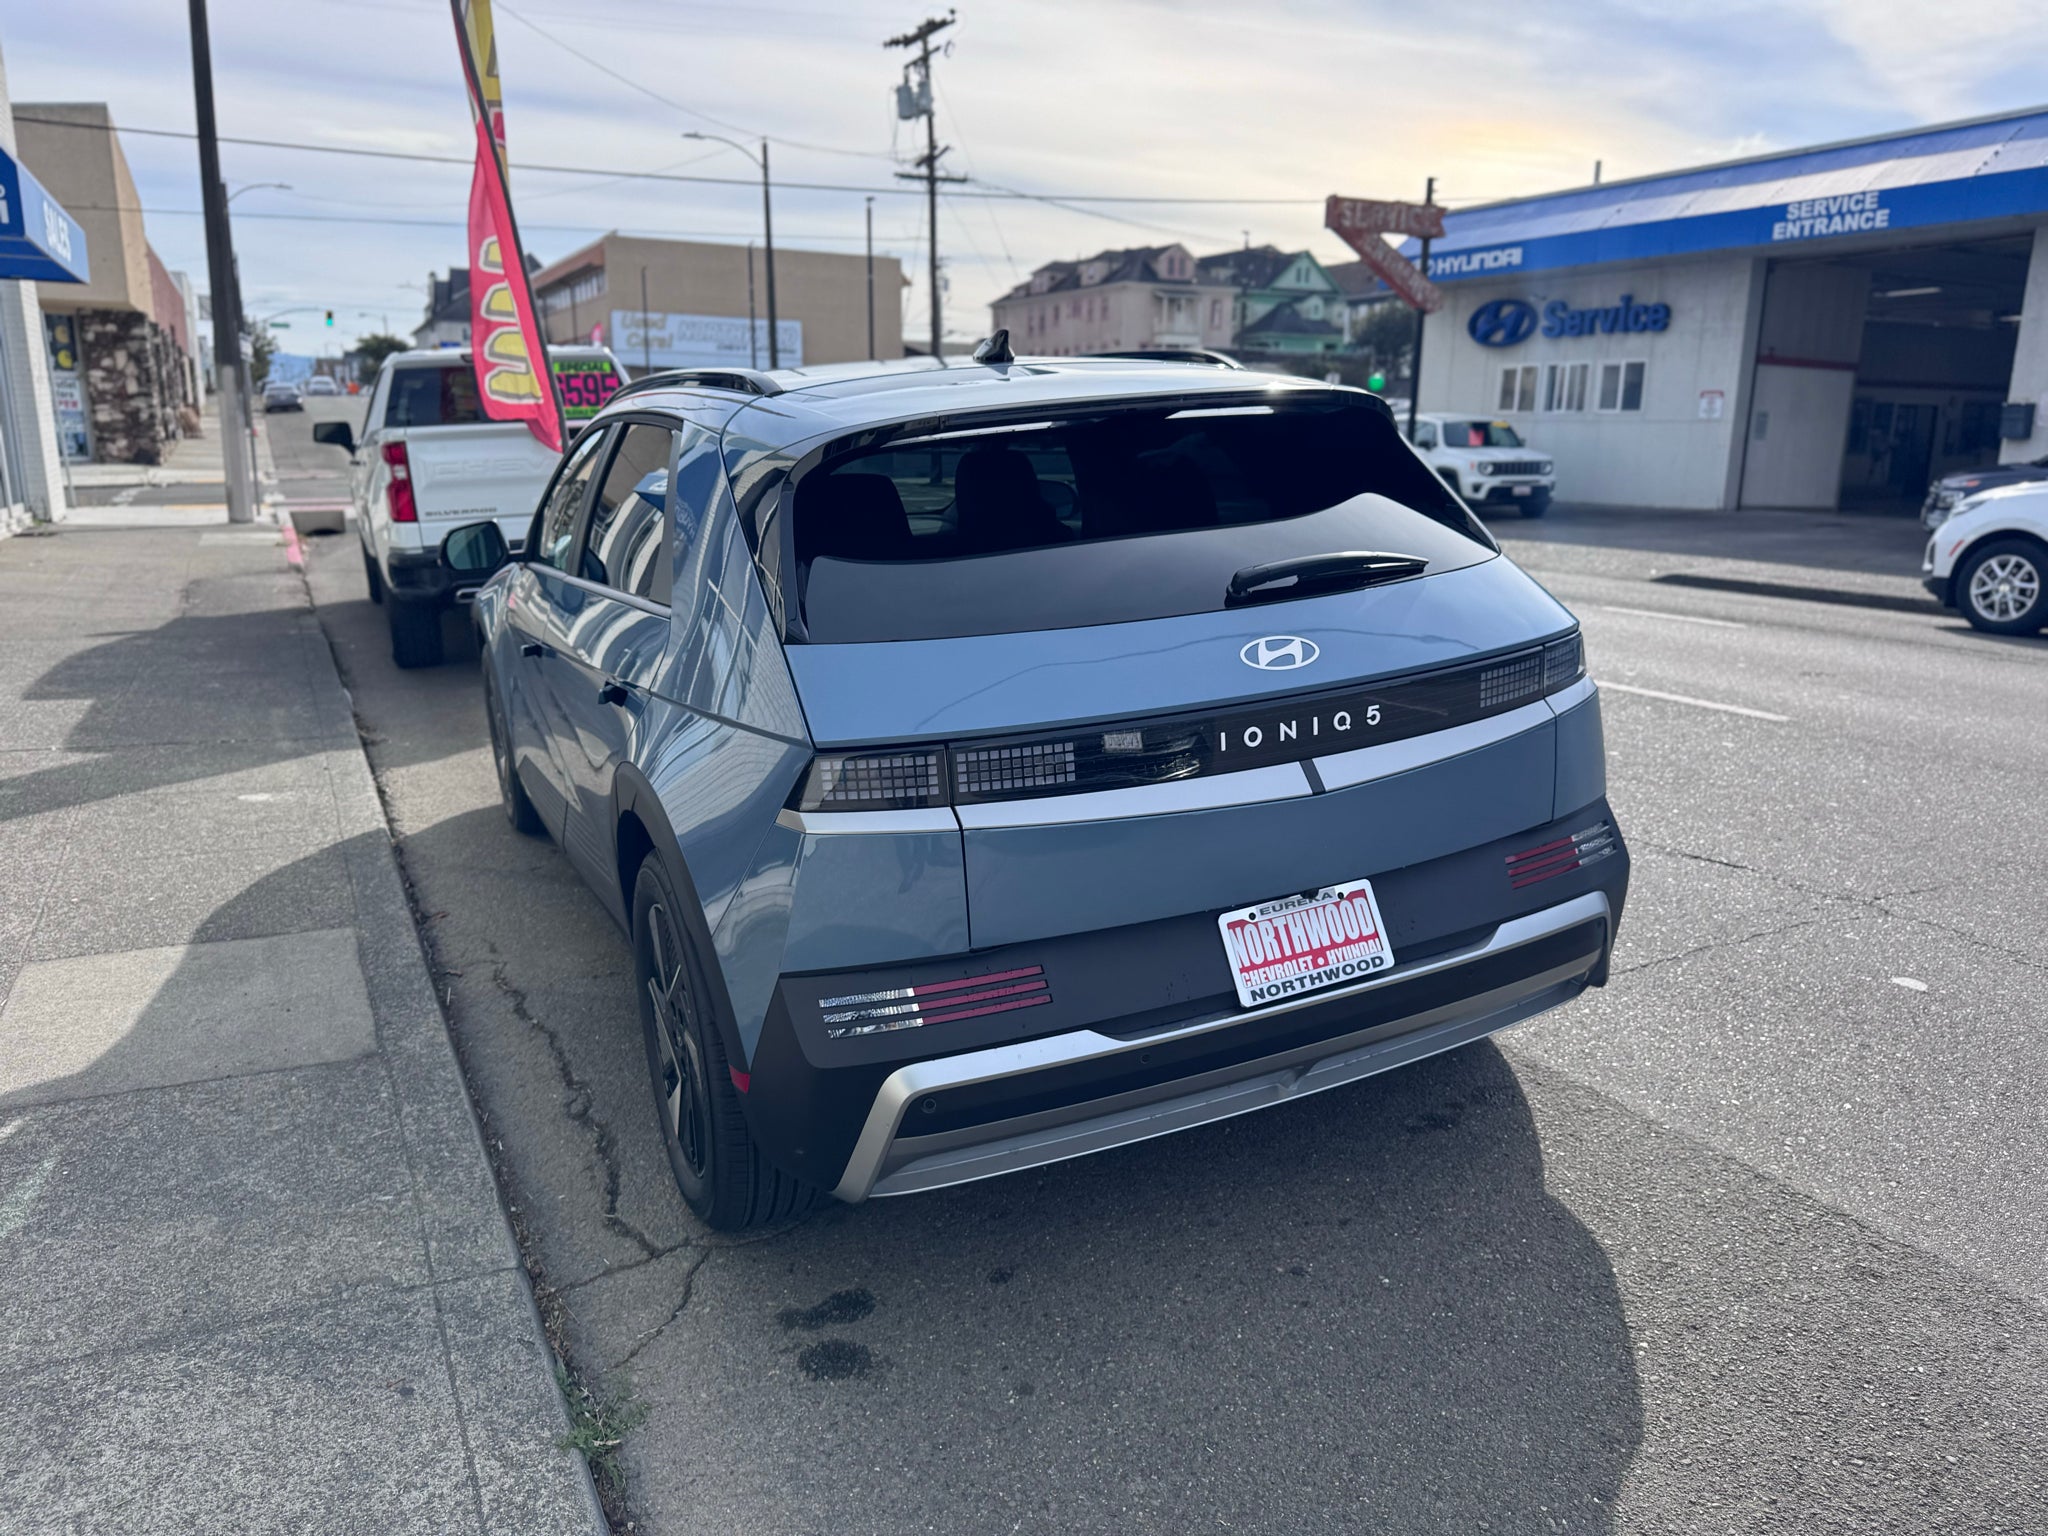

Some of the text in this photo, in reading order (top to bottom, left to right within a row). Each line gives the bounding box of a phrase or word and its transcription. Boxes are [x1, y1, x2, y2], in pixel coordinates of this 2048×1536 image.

[1772, 209, 1890, 241] ENTRANCE
[1787, 191, 1879, 220] SERVICE
[1436, 248, 1523, 275] HYUNDAI
[1541, 294, 1672, 338] Service
[1220, 704, 1381, 751] IONIQ 5
[1229, 897, 1376, 968] NORTHWOOD
[1241, 937, 1383, 987] CHEVROLET HYUNDAI
[1250, 955, 1384, 1002] NORTHWOOD
